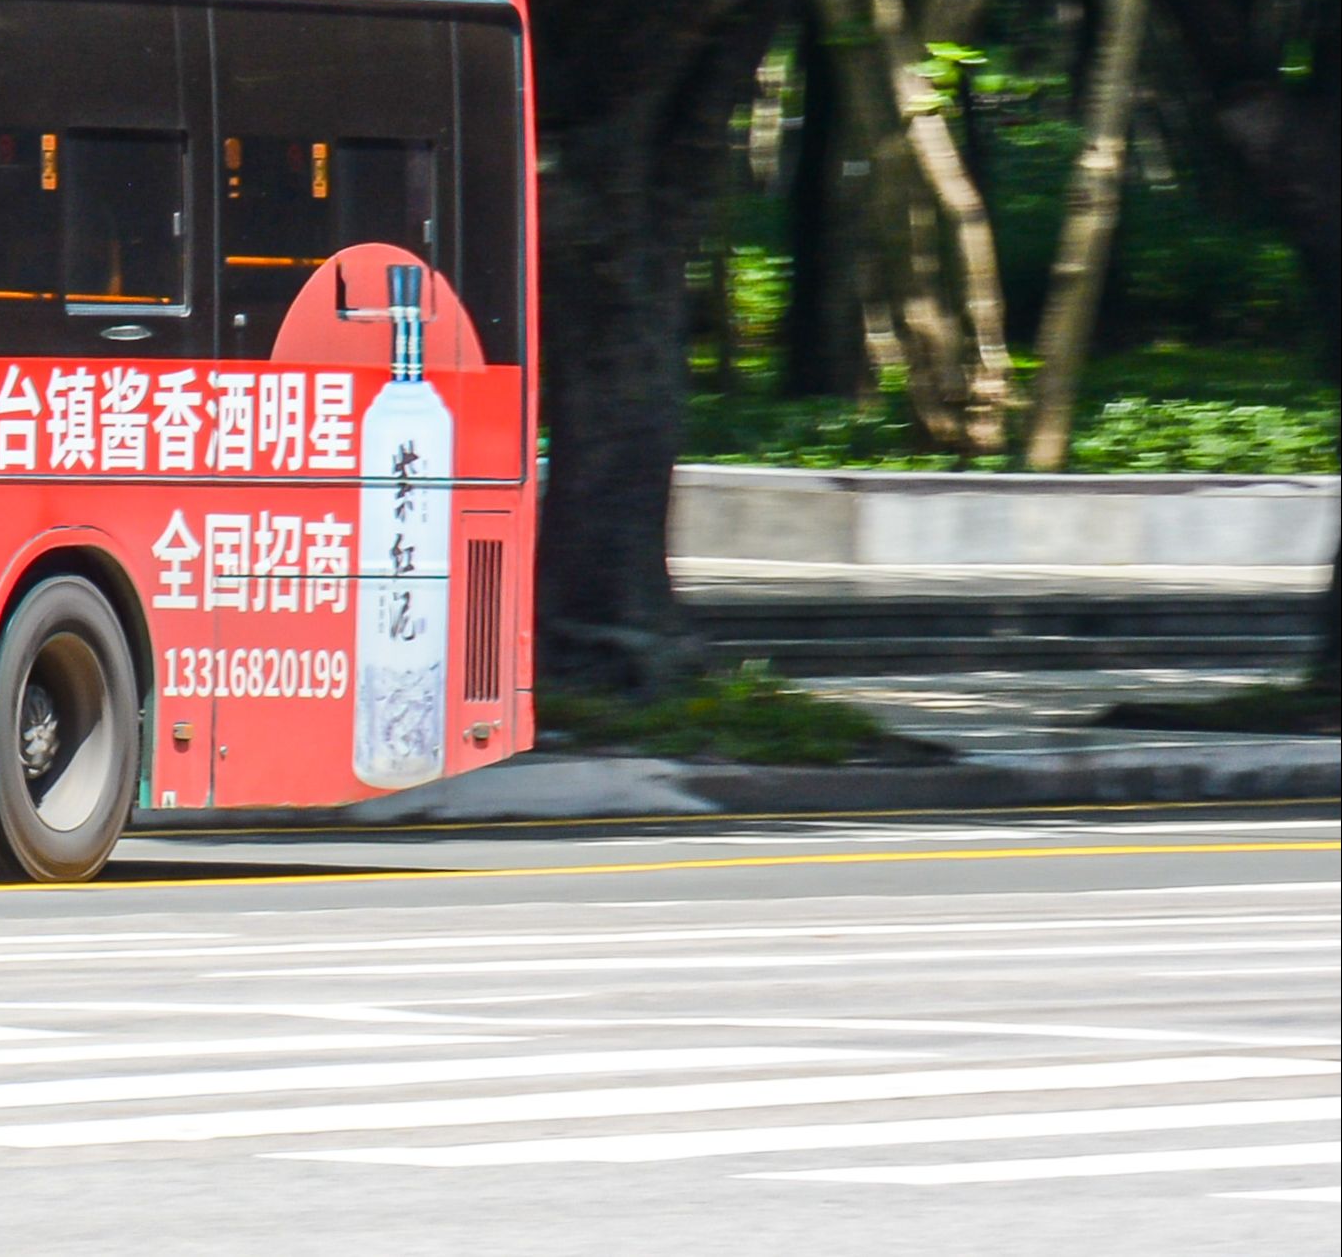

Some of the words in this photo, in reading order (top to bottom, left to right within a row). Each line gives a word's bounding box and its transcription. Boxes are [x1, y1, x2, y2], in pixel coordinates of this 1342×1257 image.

[152, 509, 354, 613] 全国招商
[163, 647, 350, 699] 13316820199
